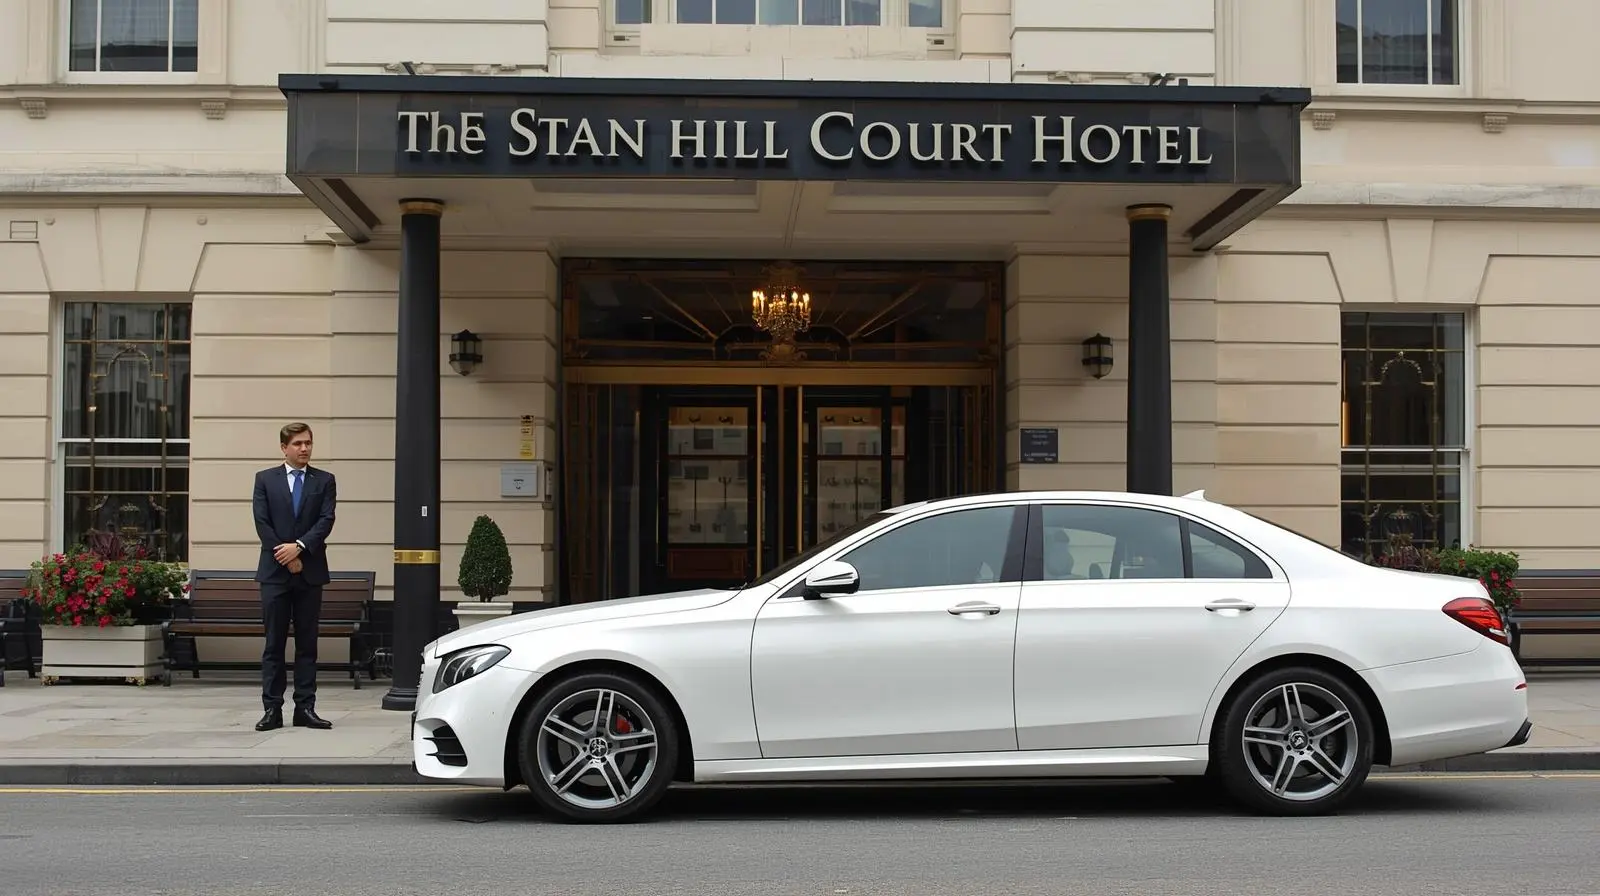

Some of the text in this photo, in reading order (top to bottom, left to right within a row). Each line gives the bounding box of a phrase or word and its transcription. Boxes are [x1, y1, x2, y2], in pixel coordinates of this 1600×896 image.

[508, 108, 647, 158] STAN
[669, 119, 789, 160] HILL
[810, 111, 1012, 162] COURT
[1031, 115, 1213, 165] HOTEL
